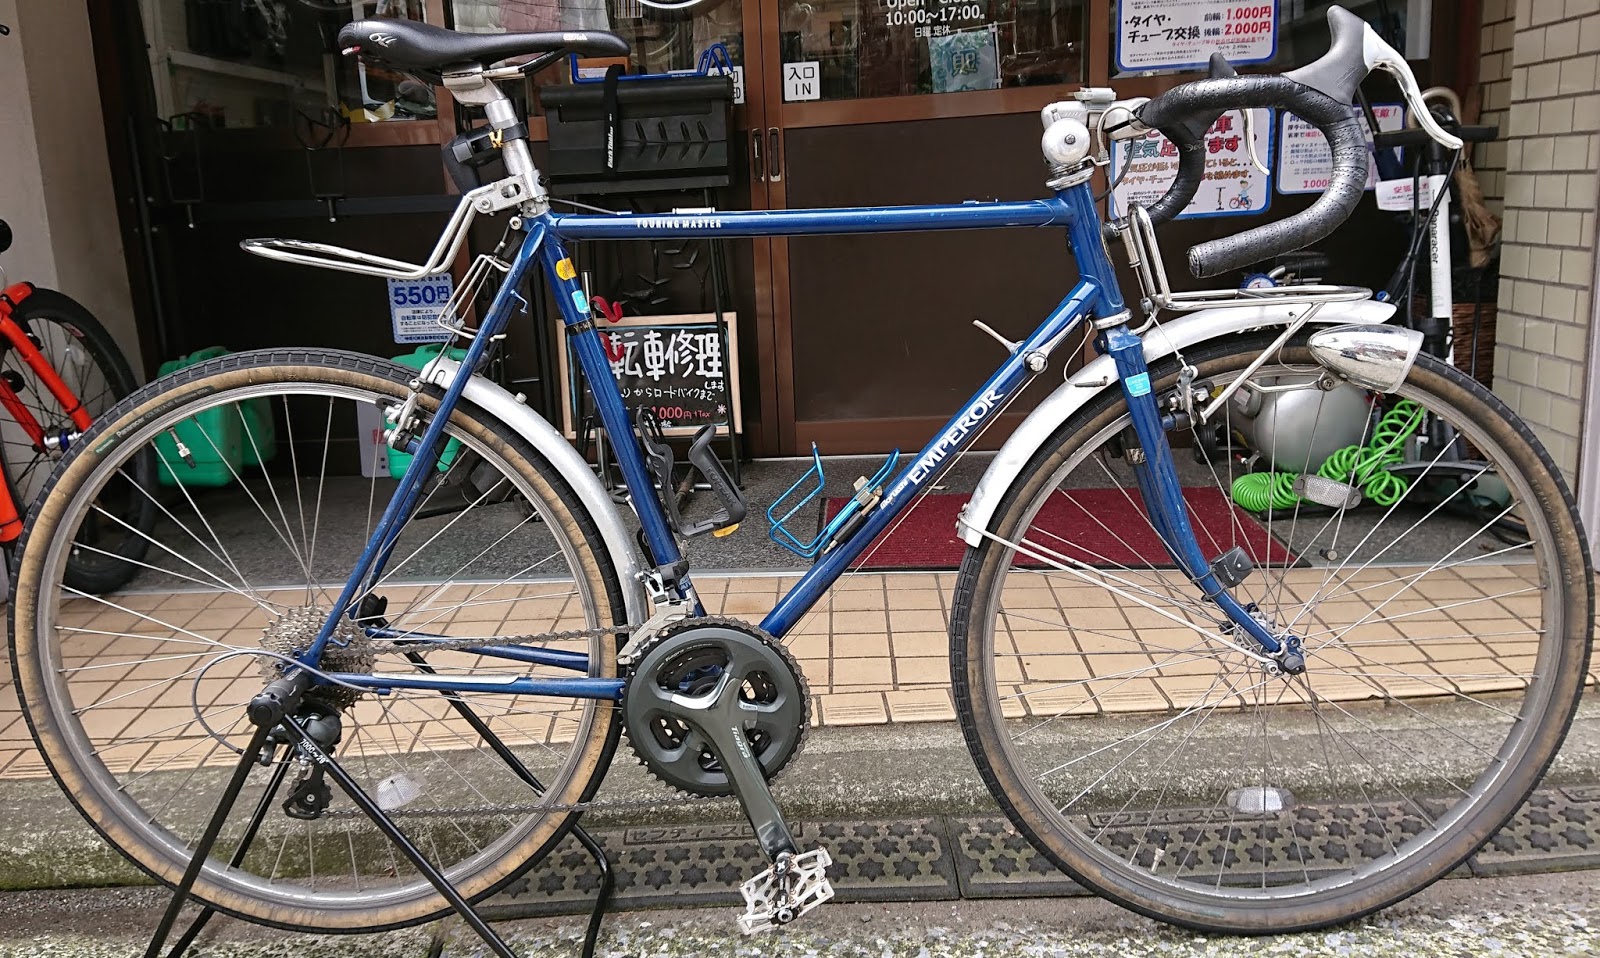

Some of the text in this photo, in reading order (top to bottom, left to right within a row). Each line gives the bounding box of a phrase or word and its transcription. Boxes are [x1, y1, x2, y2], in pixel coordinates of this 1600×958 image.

[1128, 25, 1200, 43] チューブ交換
[789, 66, 814, 80] 入口
[795, 82, 811, 95] IN
[636, 219, 722, 229] TOURING MASTER
[394, 286, 450, 305] 550円
[610, 329, 724, 381] 転車修理
[620, 385, 718, 403] りからロードバイクまで。
[704, 380, 725, 392] します
[908, 389, 1004, 485] EMPEROR
